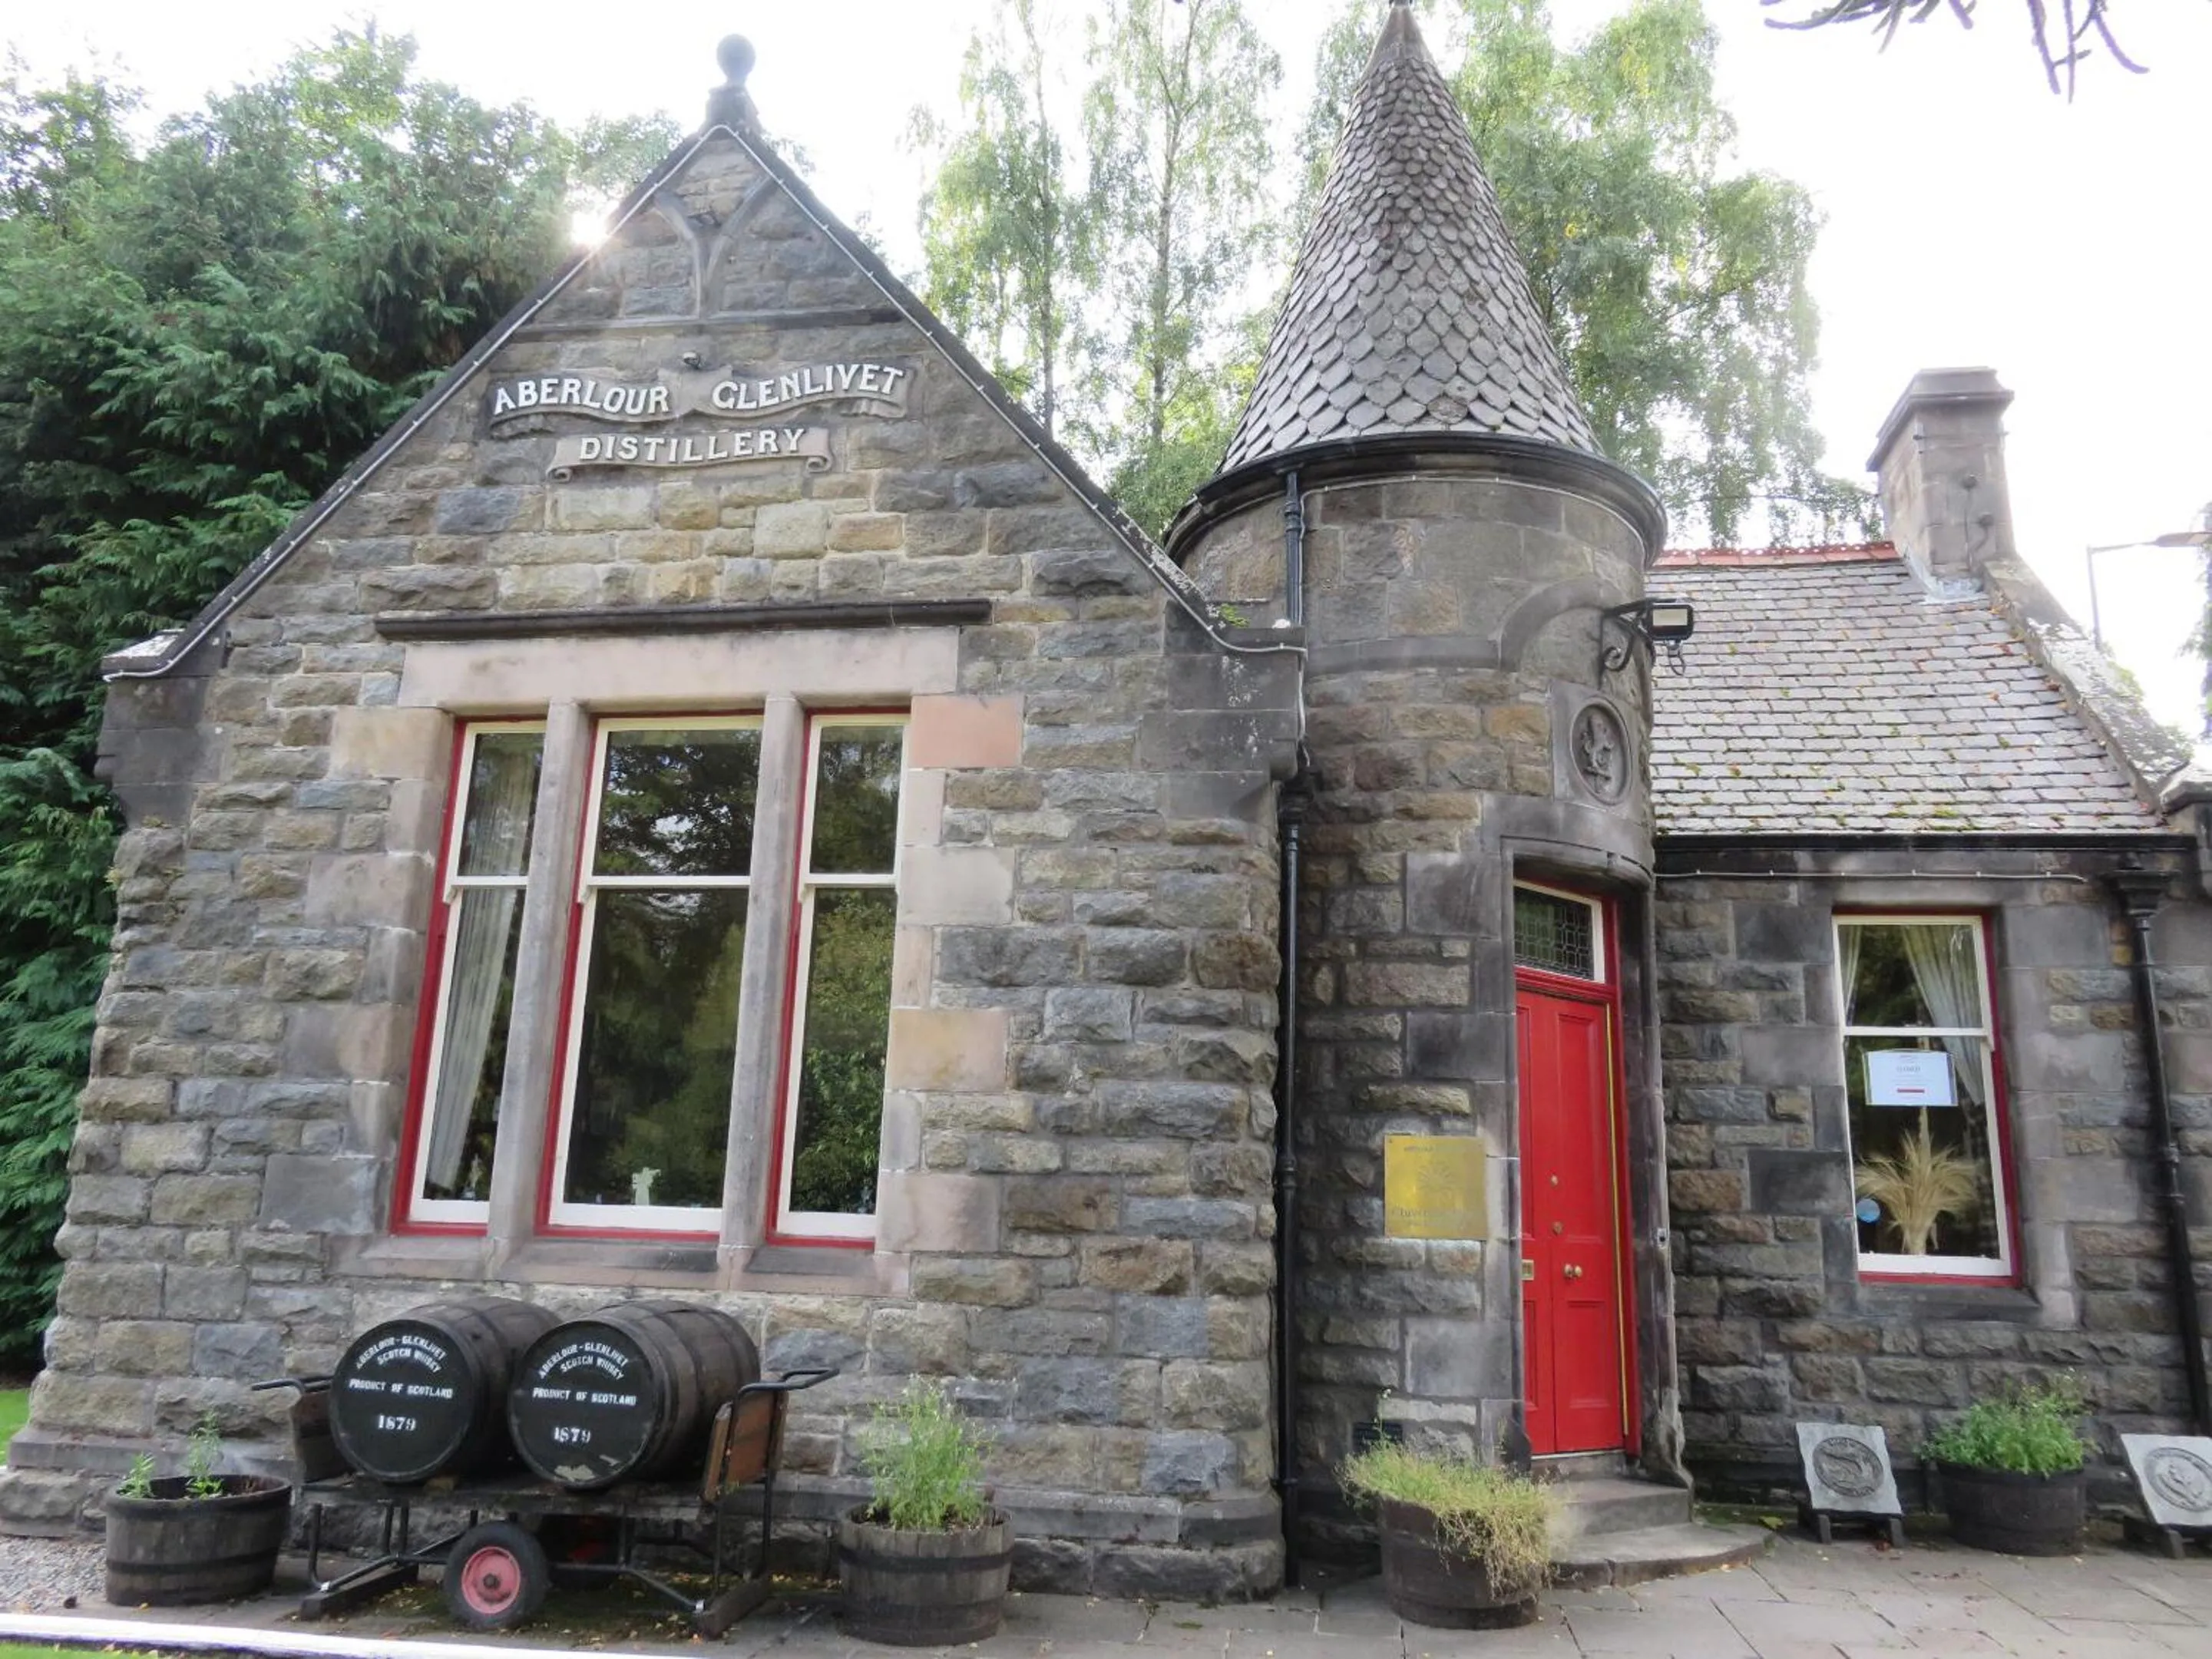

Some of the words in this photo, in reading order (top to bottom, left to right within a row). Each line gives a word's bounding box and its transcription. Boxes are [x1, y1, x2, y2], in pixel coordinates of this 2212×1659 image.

[493, 378, 670, 415] ABERLOUR
[712, 364, 904, 410] GLENLIVET
[580, 428, 805, 461] DISTILLERY
[377, 1348, 412, 1365] SCOTCH
[414, 1350, 441, 1373] WHISKY
[560, 1355, 594, 1373] SCOTCH
[597, 1357, 624, 1380] WHISKY
[349, 1379, 386, 1390] PRODUCT
[392, 1383, 403, 1393] OF
[407, 1385, 454, 1399] SCOTLAND
[532, 1387, 571, 1400] PRODUCT
[576, 1392, 587, 1401] OF
[591, 1393, 636, 1406] SCOTLAND
[378, 1414, 416, 1431] 1879
[554, 1426, 590, 1443] 1879
